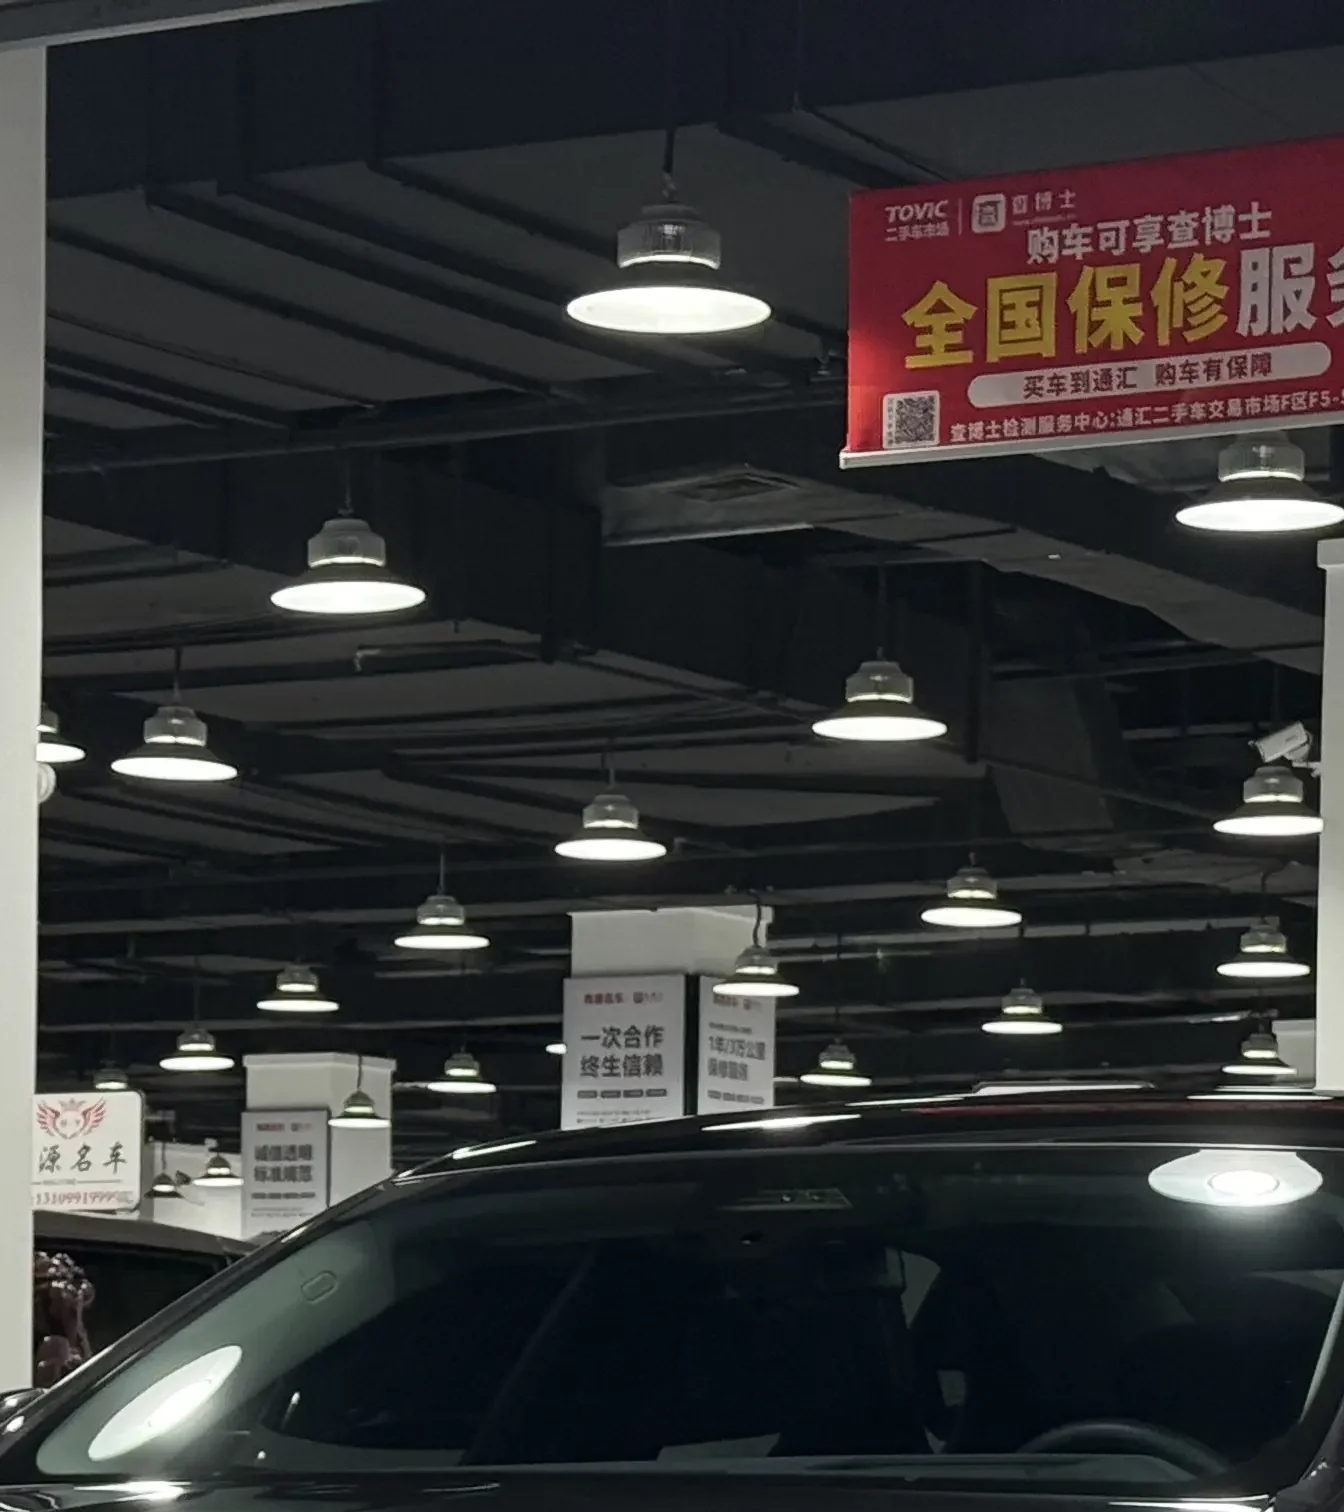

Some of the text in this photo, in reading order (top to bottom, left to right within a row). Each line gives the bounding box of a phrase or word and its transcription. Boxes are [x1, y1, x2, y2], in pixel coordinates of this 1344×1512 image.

[885, 200, 949, 224] TOVIC
[1027, 201, 1273, 264] 购车可享查博士
[1023, 352, 1273, 399] 买车到通汇 购车有保障
[581, 1024, 664, 1050] 一次合作
